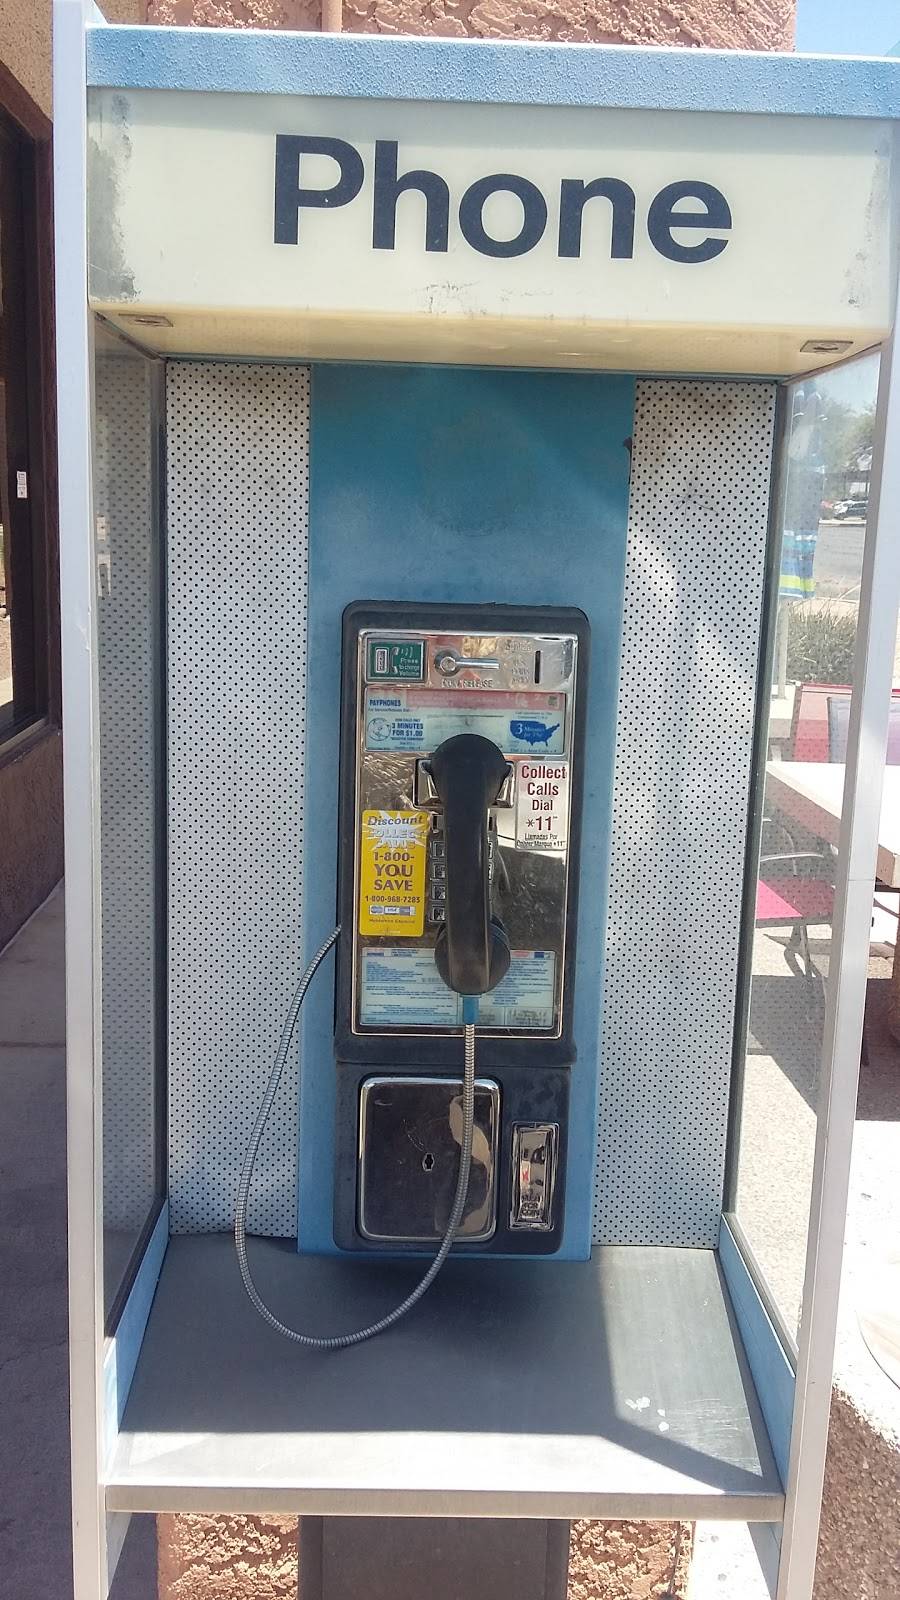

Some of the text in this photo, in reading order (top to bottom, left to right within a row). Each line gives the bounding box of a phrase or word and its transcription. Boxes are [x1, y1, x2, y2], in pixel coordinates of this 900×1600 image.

[273, 133, 733, 264] Phone
[516, 723, 522, 734] 3
[522, 765, 566, 779] Collect
[528, 782, 558, 796] Calls
[532, 800, 552, 810] Dial
[368, 815, 422, 826] Discount
[374, 852, 414, 862] 1-800-
[374, 864, 413, 877] YOU
[374, 880, 413, 891] SAVE
